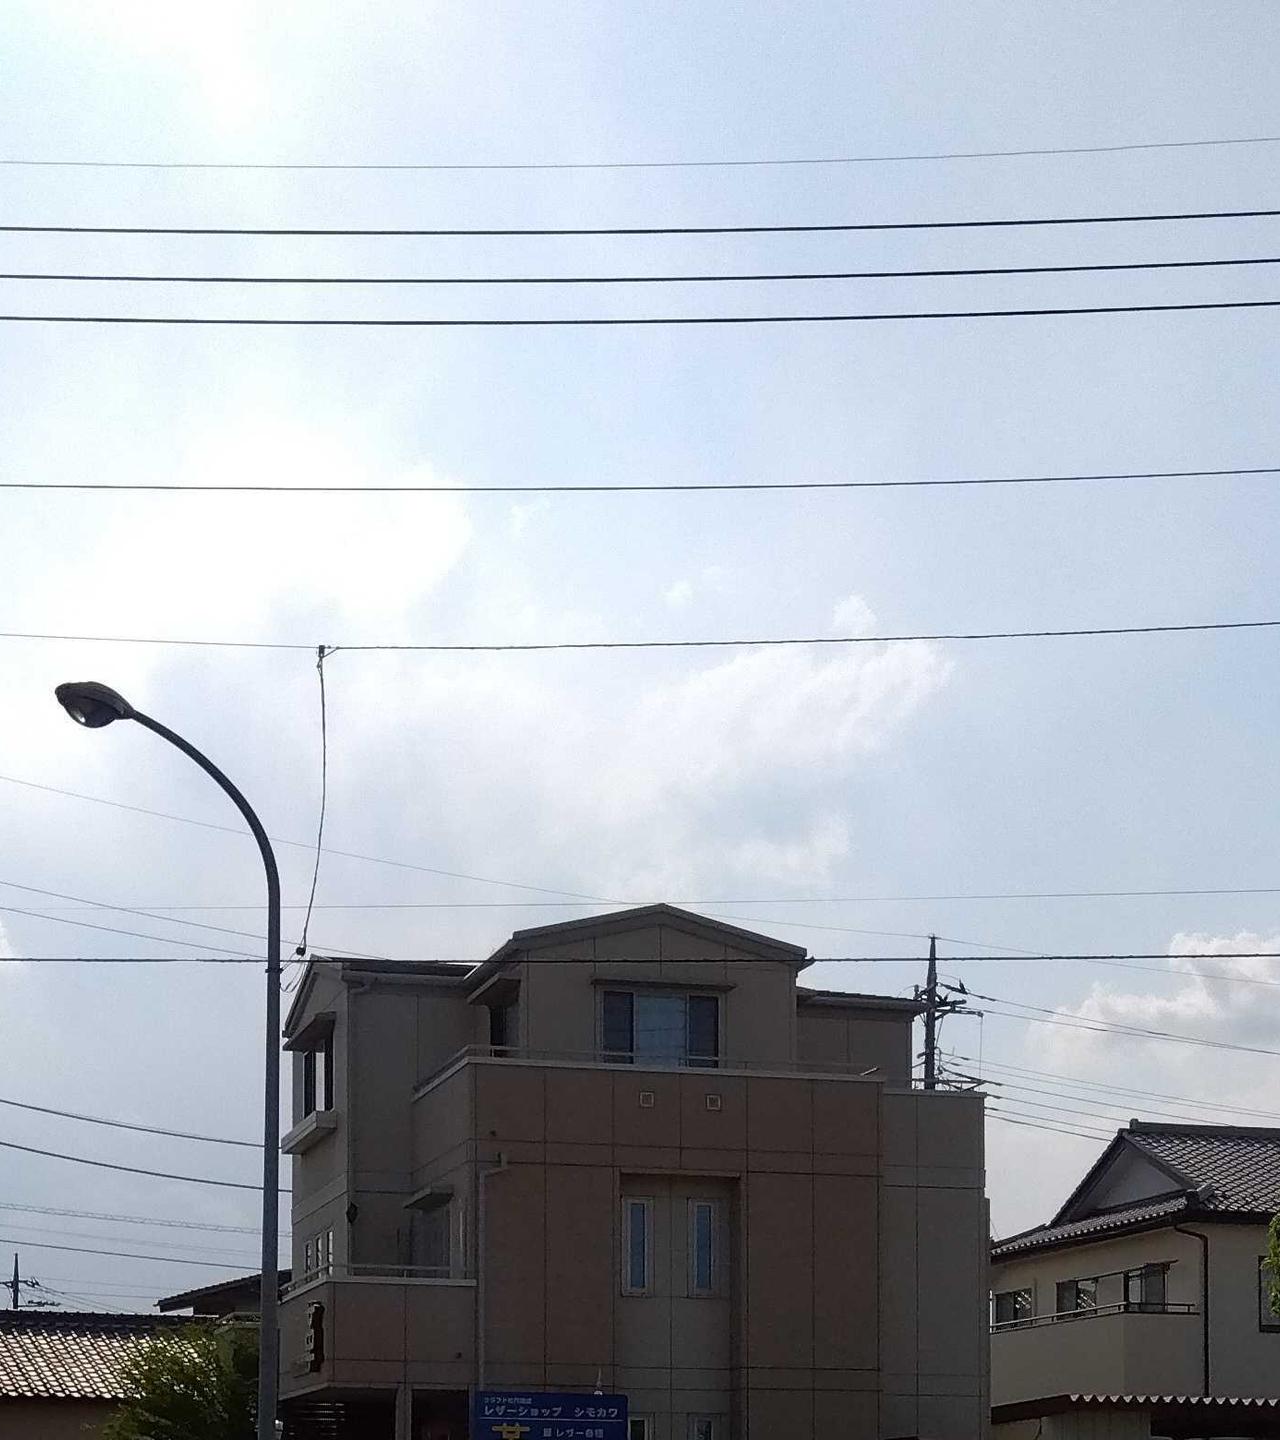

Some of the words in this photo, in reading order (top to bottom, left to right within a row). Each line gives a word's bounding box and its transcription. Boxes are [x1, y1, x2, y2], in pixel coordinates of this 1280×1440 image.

[484, 1405, 562, 1417] レザーショップ
[574, 1407, 618, 1418] シモカワ
